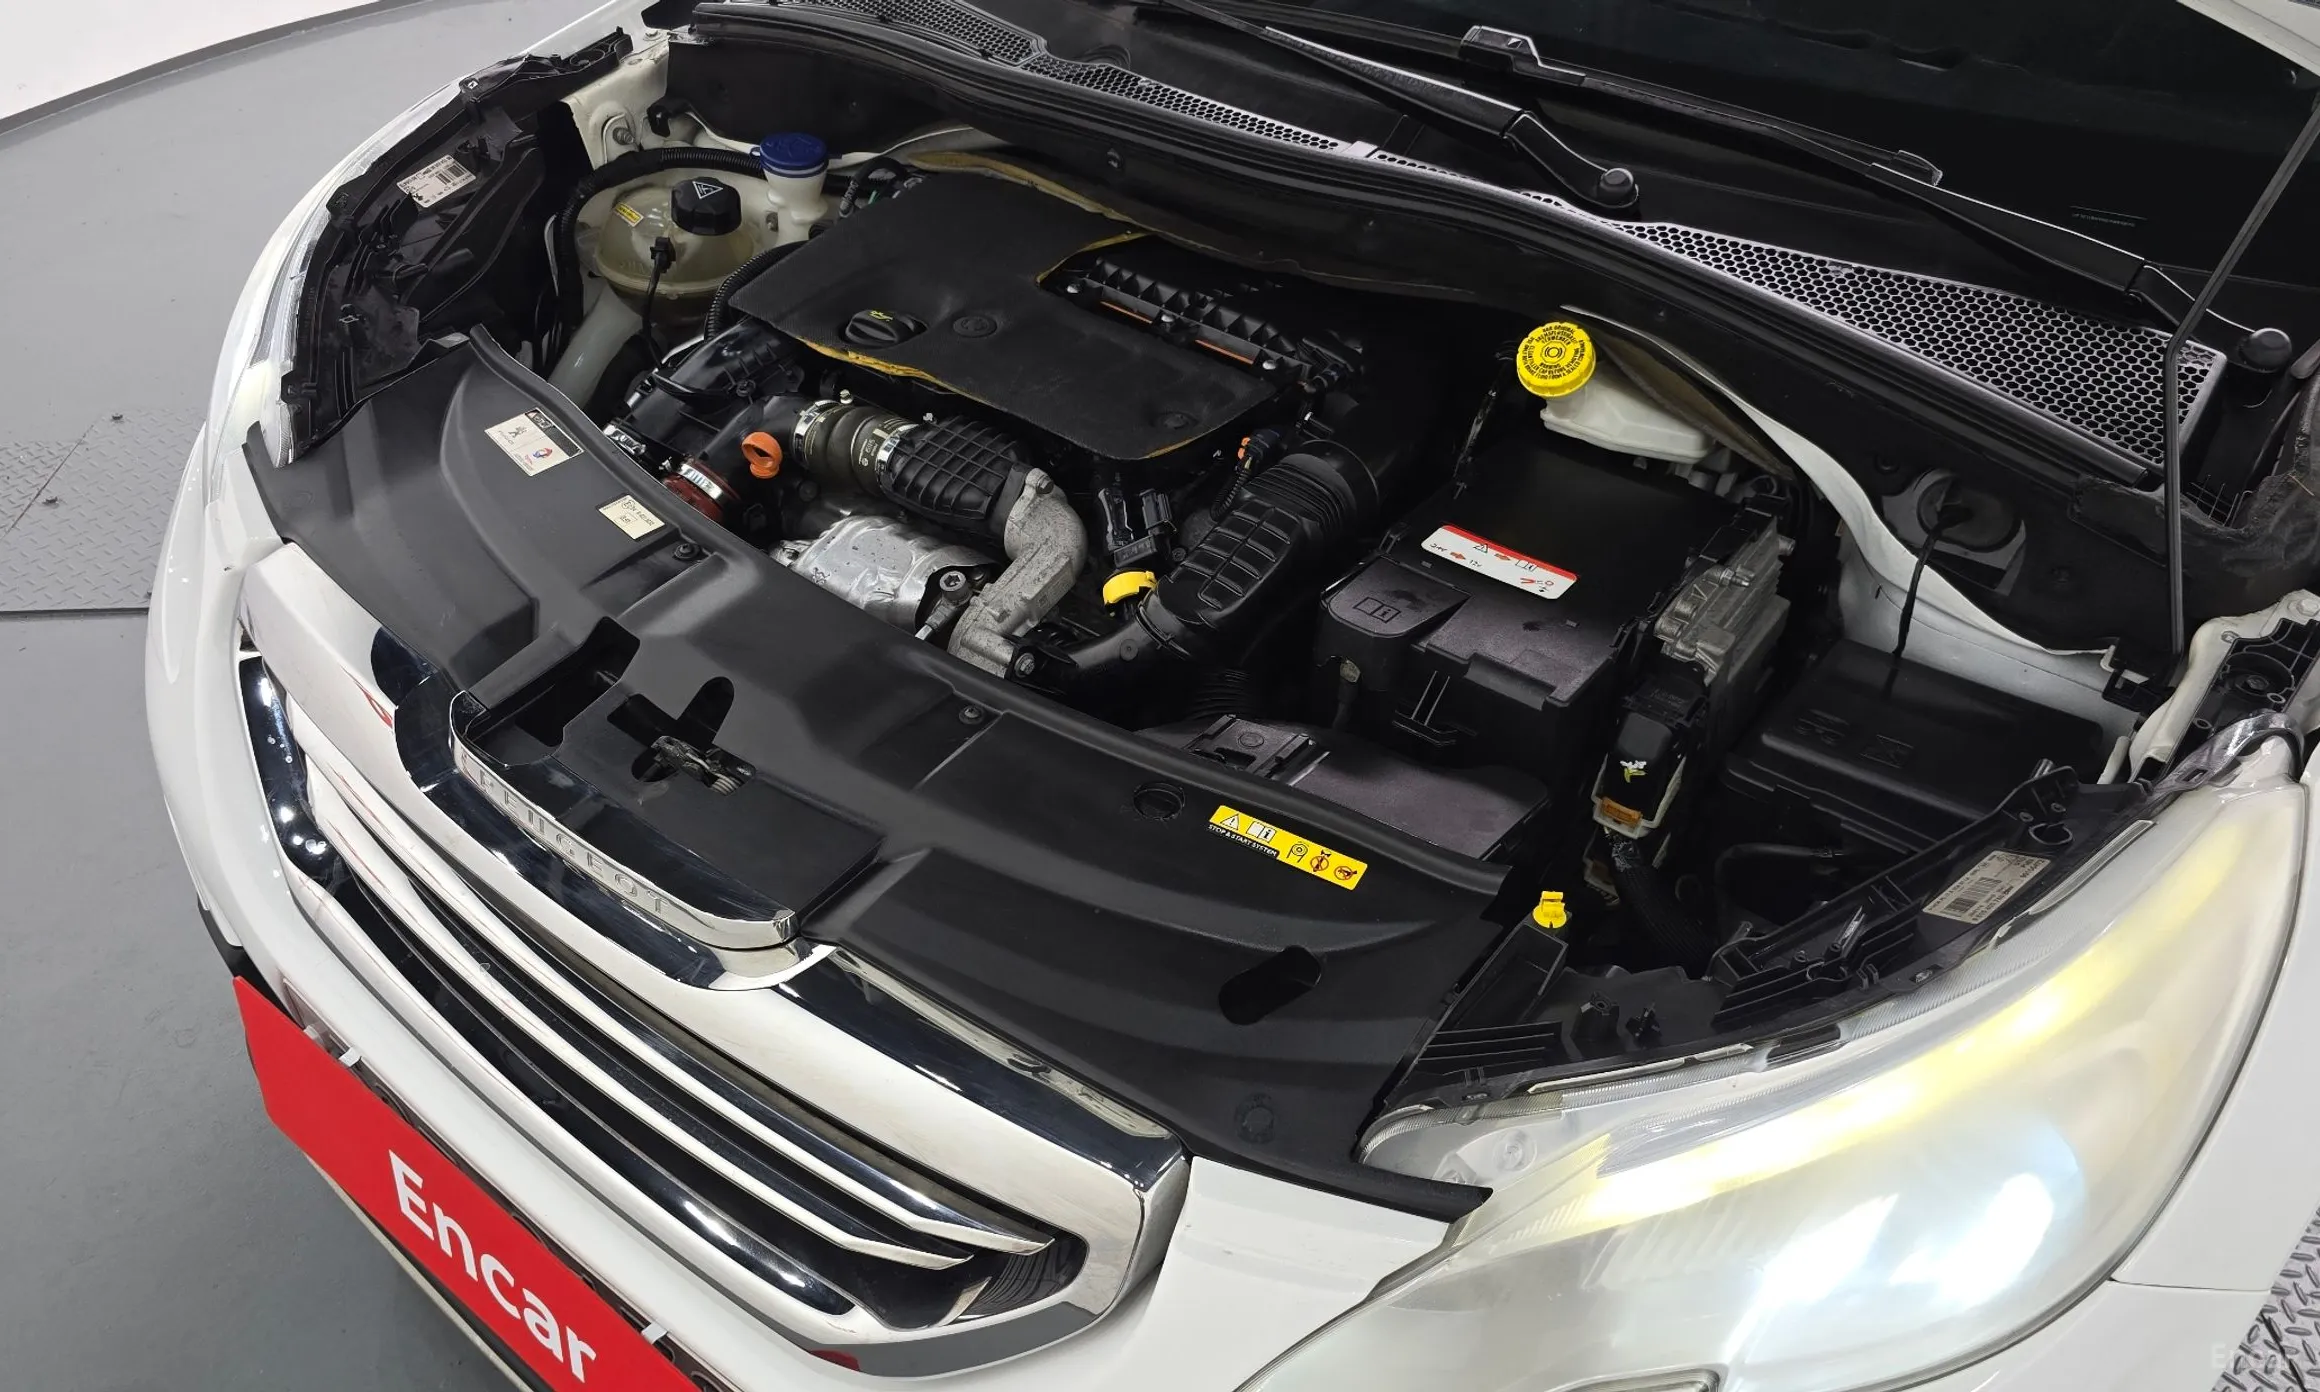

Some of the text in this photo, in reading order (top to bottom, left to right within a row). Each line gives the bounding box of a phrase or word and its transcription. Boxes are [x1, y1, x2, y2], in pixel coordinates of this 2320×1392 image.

[479, 769, 670, 915] PEUGEOT
[1208, 824, 1226, 834] STOP
[1252, 842, 1277, 857] SYSTEM
[388, 1149, 597, 1384] Encar
